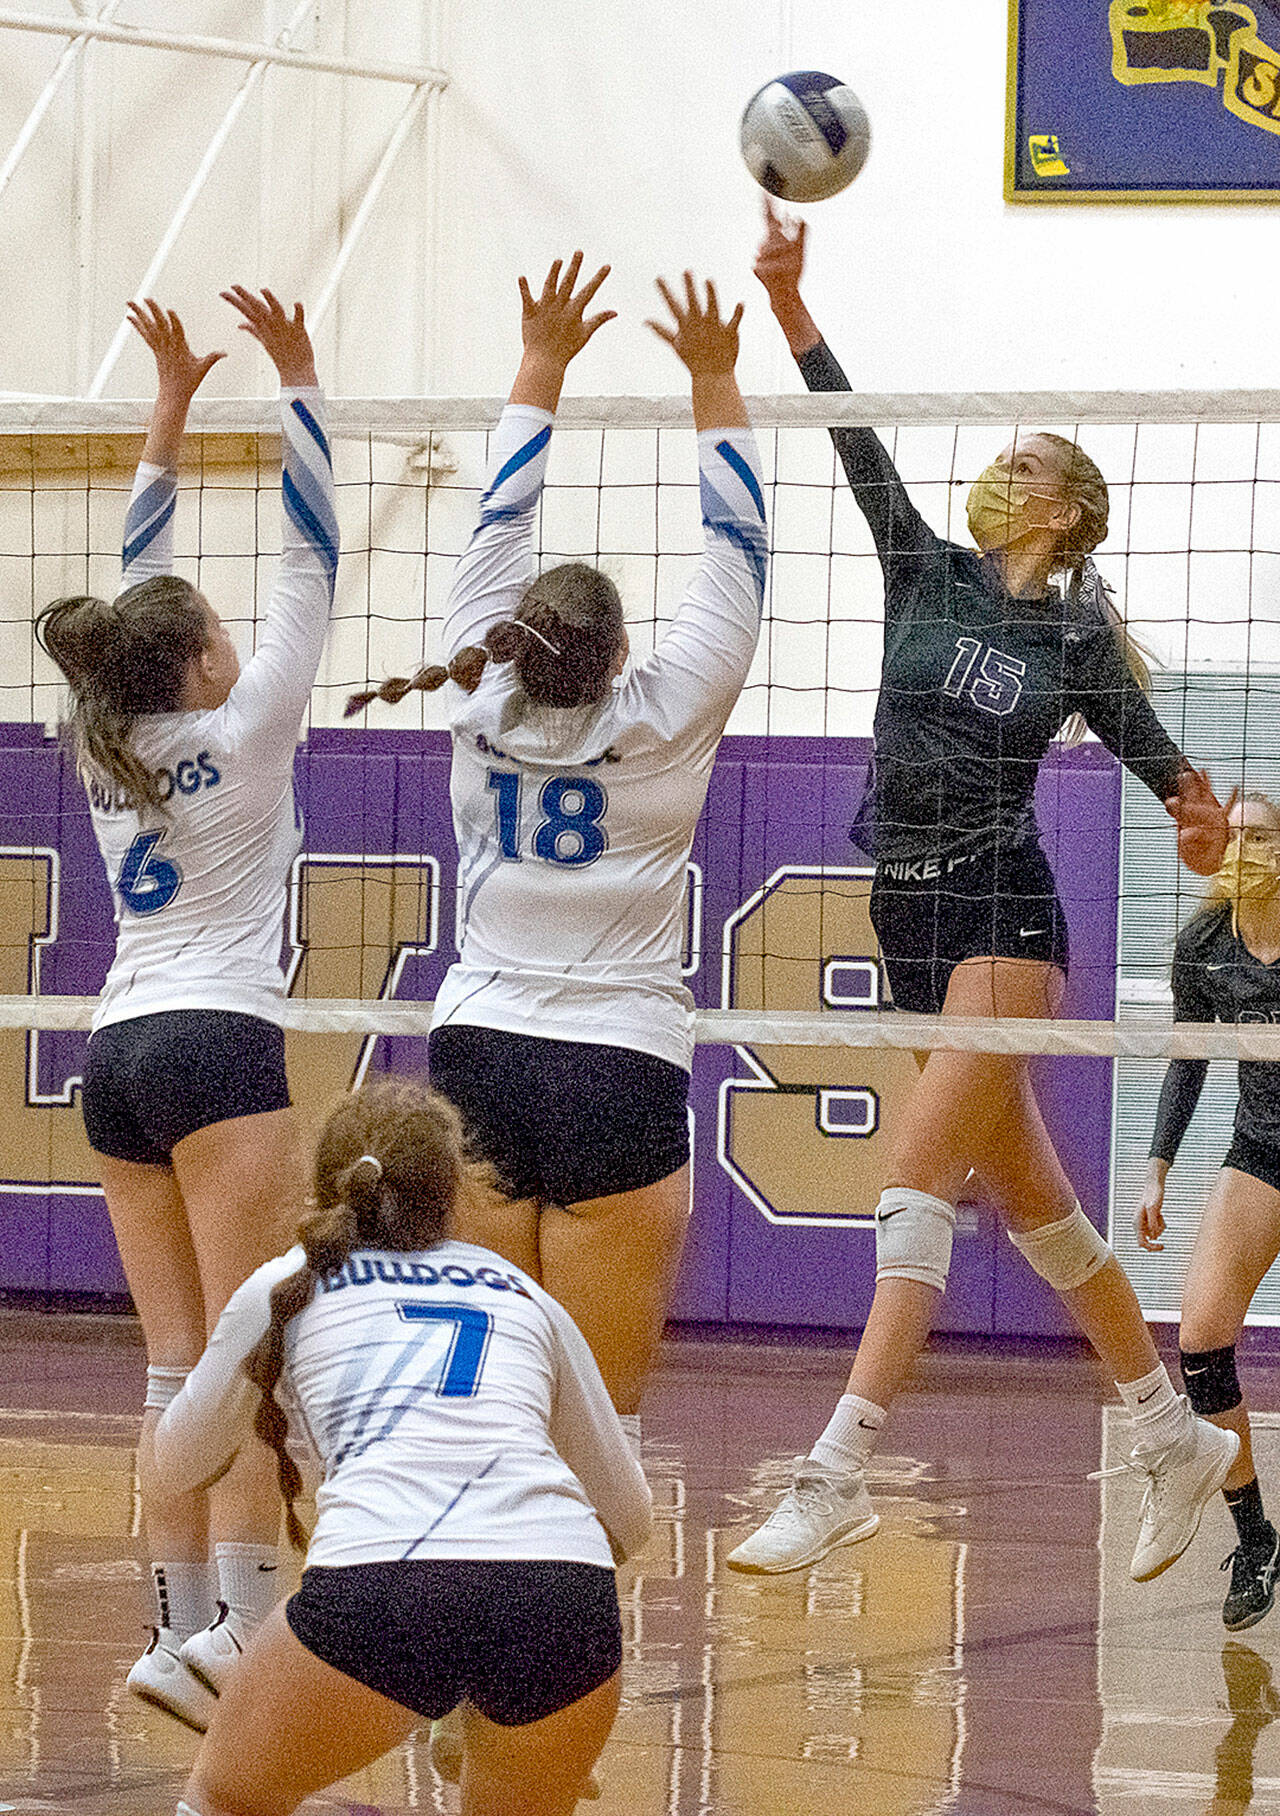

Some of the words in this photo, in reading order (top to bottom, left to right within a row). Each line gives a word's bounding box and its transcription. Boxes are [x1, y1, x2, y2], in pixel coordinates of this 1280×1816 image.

[944, 637, 1026, 716] 15
[486, 766, 610, 870] 18
[115, 826, 184, 918] 6
[883, 858, 942, 881] NIKE
[395, 1299, 494, 1398] 7
